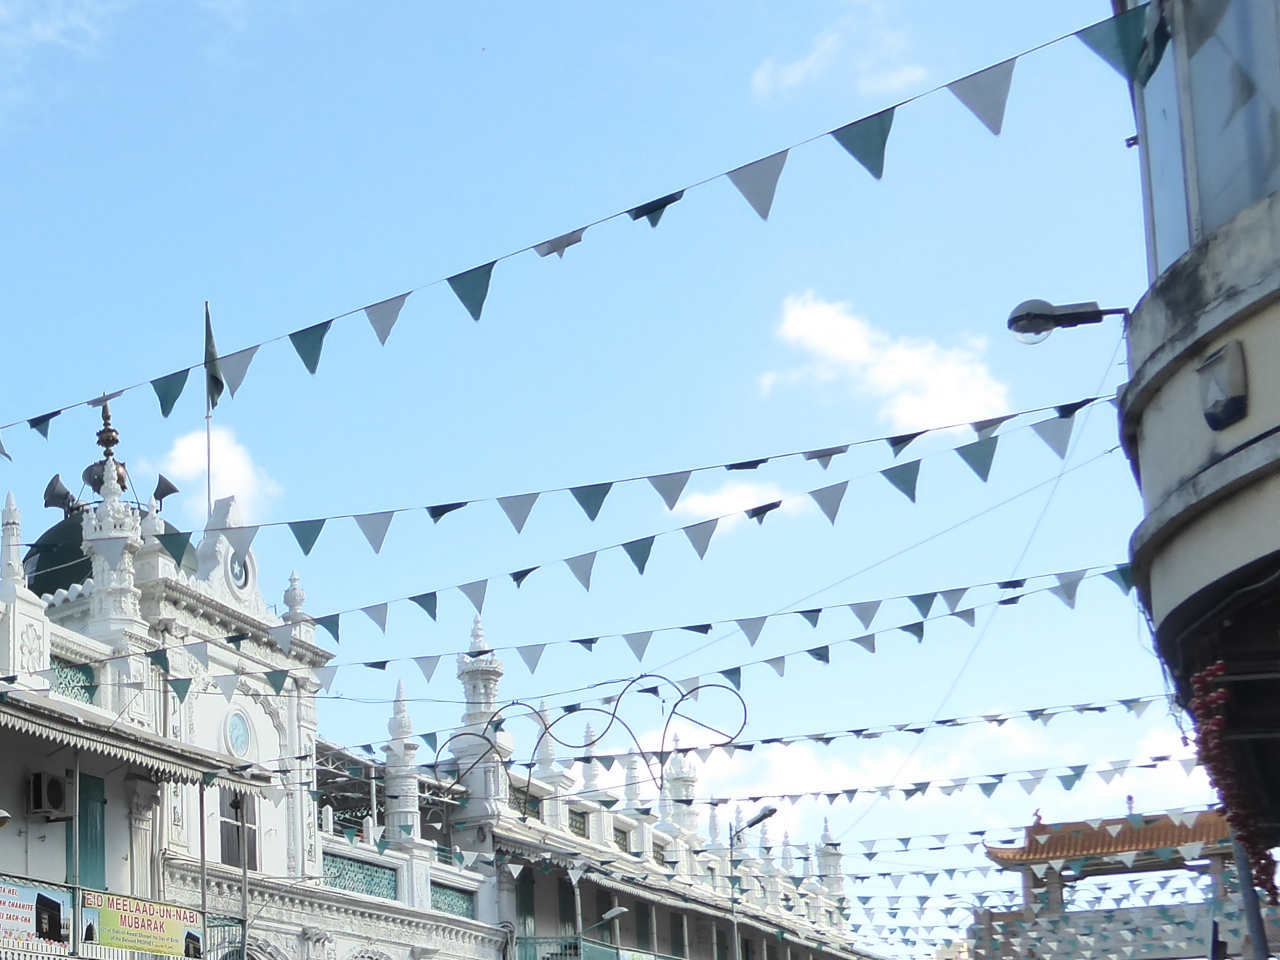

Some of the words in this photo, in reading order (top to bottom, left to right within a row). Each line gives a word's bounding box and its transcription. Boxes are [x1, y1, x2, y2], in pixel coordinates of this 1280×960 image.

[86, 893, 103, 907] EID
[108, 897, 198, 924] MEELAAD-UN-NABI
[120, 914, 165, 933] MUBARAK
